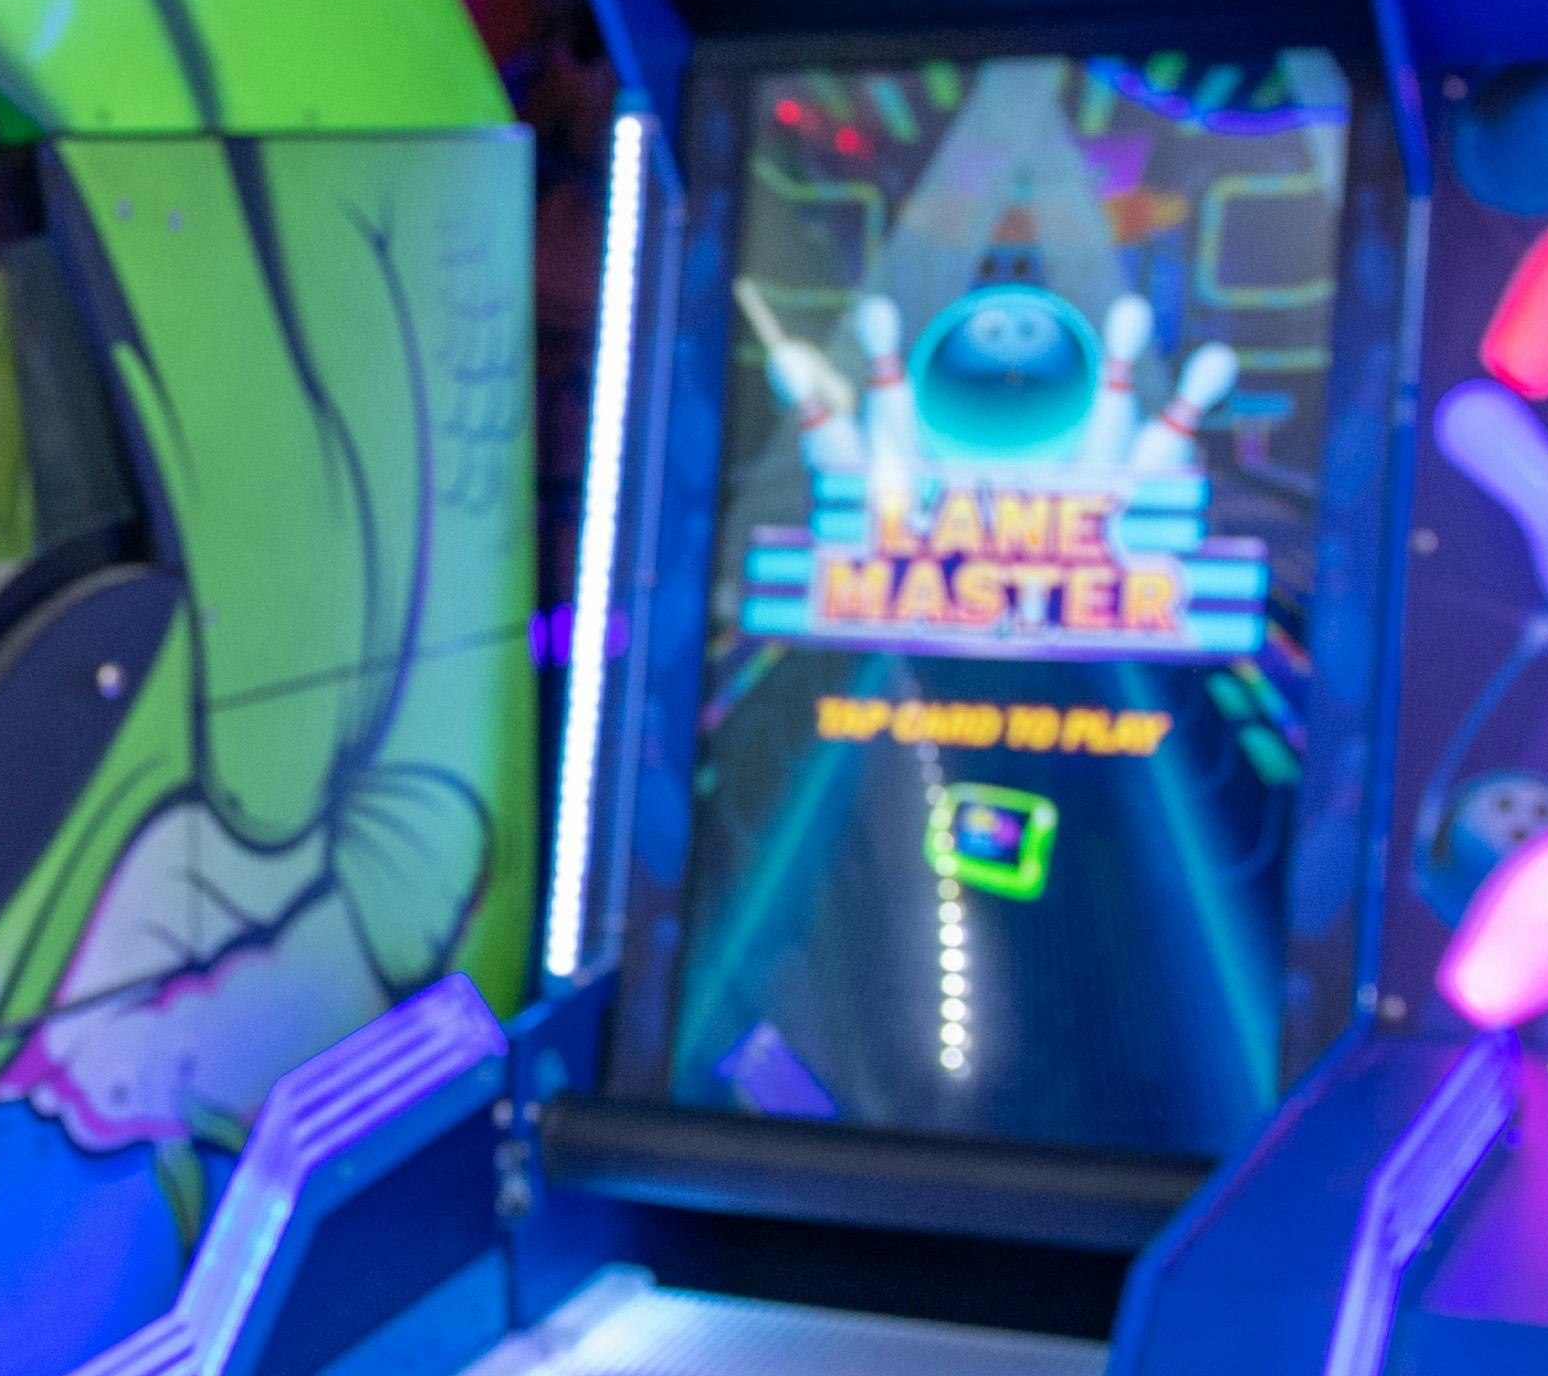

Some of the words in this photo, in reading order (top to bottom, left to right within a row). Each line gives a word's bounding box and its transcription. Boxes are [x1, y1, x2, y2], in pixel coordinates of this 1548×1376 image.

[876, 490, 1120, 560] LANE
[816, 562, 1184, 632] MASTER
[815, 696, 889, 741] TAP
[892, 700, 1000, 747] CARD
[1005, 704, 1059, 751] TO
[1060, 709, 1172, 756] PLAY
